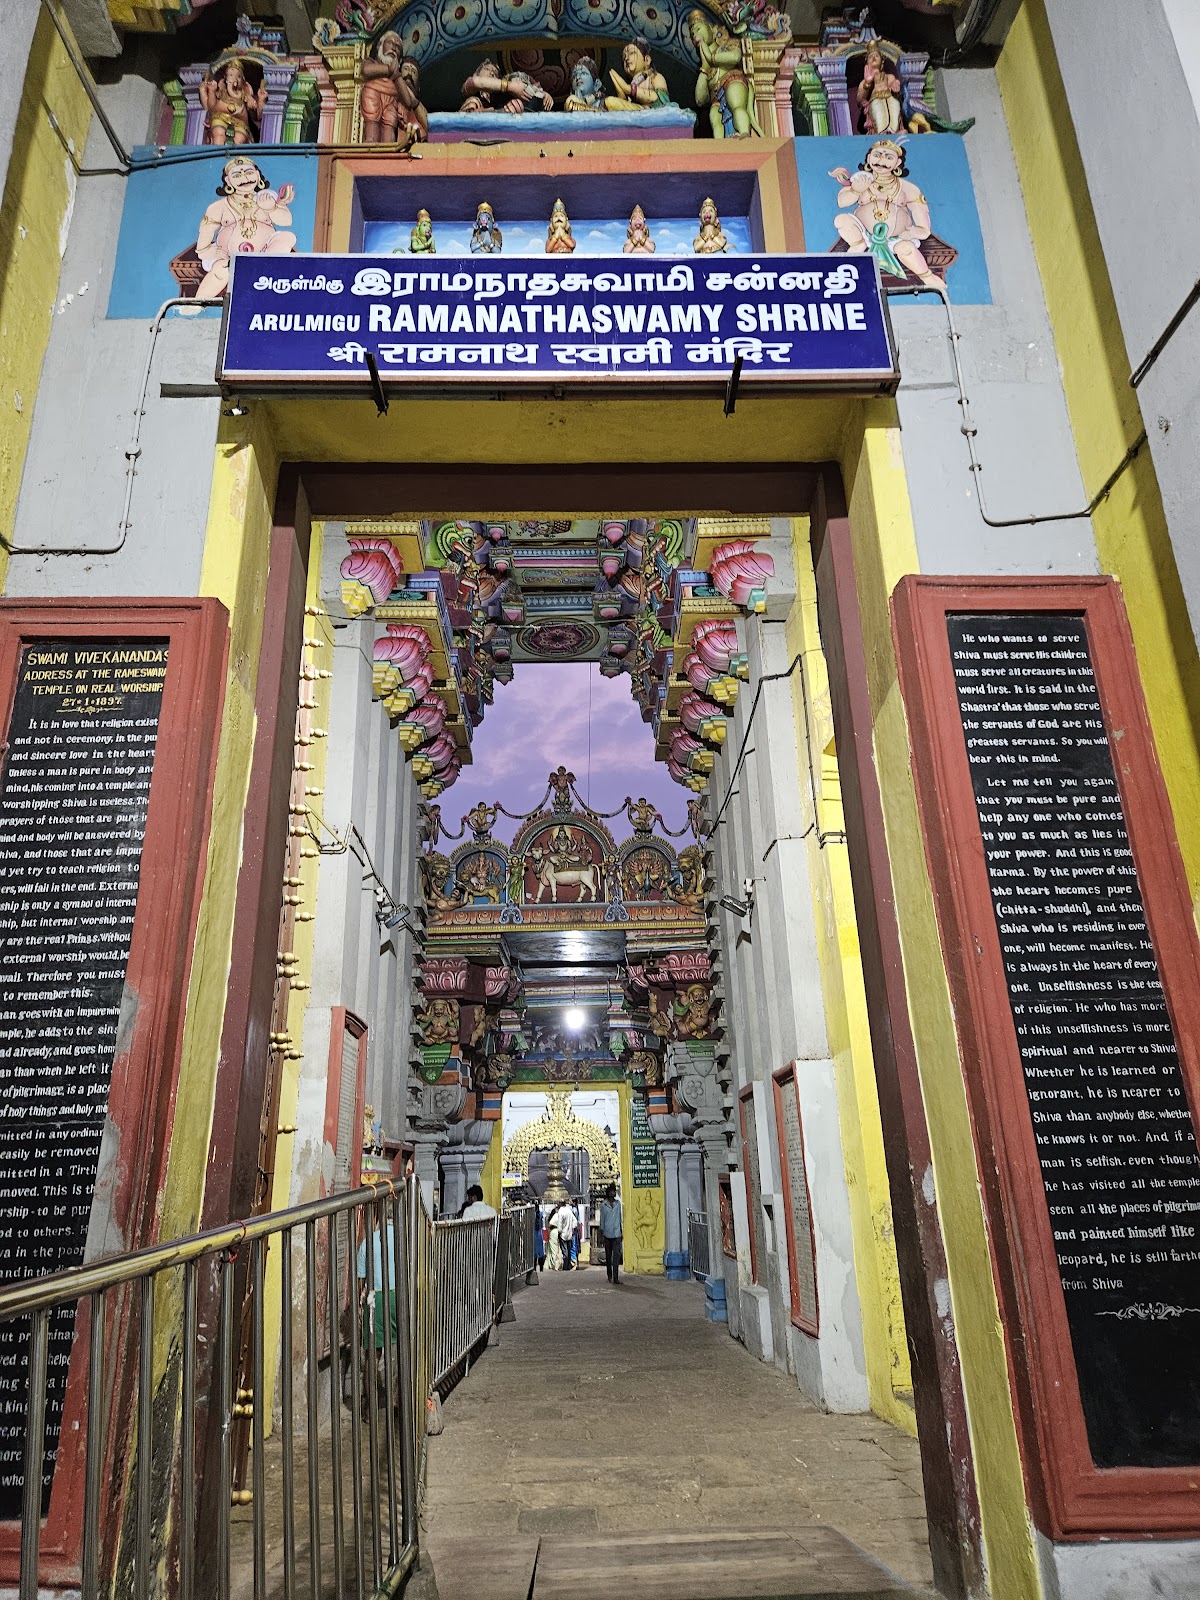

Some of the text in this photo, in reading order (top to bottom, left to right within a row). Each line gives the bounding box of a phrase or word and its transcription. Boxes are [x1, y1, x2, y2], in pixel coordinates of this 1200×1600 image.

[254, 264, 859, 301] அருள்மிகு இராமநாதசுவாமி சன்னதி
[249, 303, 866, 337] ARULMIGU RAMANATHASWAMY SHRINE
[327, 337, 792, 364] श्री रामनाथ स्वामी मंदिर
[962, 634, 975, 642] He
[978, 635, 1000, 643] who
[28, 653, 68, 665] SWAMI
[983, 651, 1008, 659] must
[1036, 651, 1050, 659] His
[1051, 649, 1087, 659] children
[24, 670, 73, 681] ADDRESS
[75, 670, 88, 679] AT
[92, 669, 111, 678] THE
[33, 685, 72, 695] TEMPLE
[76, 685, 88, 693] ON
[91, 684, 116, 693] REAL
[958, 684, 985, 694] world
[1014, 685, 1023, 693] It
[1025, 684, 1036, 694] is
[1039, 683, 1062, 694] said
[1064, 684, 1075, 693] in
[1077, 683, 1095, 693] the
[28, 719, 37, 729] It
[40, 720, 48, 729] is
[51, 720, 59, 728] in
[62, 720, 79, 728] love
[101, 718, 134, 728] religion
[53, 735, 63, 743] in
[116, 734, 125, 742] in
[127, 734, 142, 742] the
[968, 738, 1008, 748] greatest
[1062, 737, 1072, 745] So
[12, 749, 156, 761] and sincere love in the heart
[970, 754, 991, 763] bear
[996, 754, 1015, 763] this
[1032, 754, 1060, 762] mind.
[69, 767, 77, 775] is
[79, 768, 100, 776] pure
[103, 765, 111, 774] in
[115, 766, 135, 775] body
[987, 778, 1006, 786] Let
[1033, 778, 1052, 786] tell
[1060, 779, 1077, 787] you
[1084, 779, 1114, 787] again
[976, 796, 1000, 805] that
[1004, 797, 1022, 806] you
[1056, 795, 1068, 803] be
[1073, 796, 1096, 806] pure
[1102, 793, 1121, 803] and
[980, 812, 1003, 825] help
[1007, 814, 1029, 823] any
[1056, 812, 1081, 821] who
[1086, 812, 1123, 821] comes
[982, 832, 994, 841] to
[997, 832, 1016, 841] you
[1040, 830, 1069, 839] much
[1074, 831, 1088, 839] as
[1092, 830, 1112, 838] lies
[1117, 829, 1127, 838] in
[8, 863, 139, 877] yet try to teach religion to
[17, 884, 33, 893] will
[34, 883, 49, 893] fail
[51, 883, 60, 892] in
[61, 883, 76, 892] the
[1026, 943, 1045, 952] will
[1090, 941, 1137, 951] manifest.
[1140, 940, 1153, 949] He
[3, 992, 14, 1001] to
[17, 990, 69, 1000] remember
[1018, 1024, 1170, 1034] of this unselfishness is more
[1025, 1068, 1074, 1077] Whether
[1080, 1065, 1094, 1076] he
[1098, 1066, 1108, 1076] is
[1111, 1065, 1156, 1075] learned
[1087, 1086, 1103, 1098] he
[1107, 1088, 1117, 1098] is
[1122, 1088, 1161, 1098] nearer
[1167, 1088, 1180, 1096] to
[1036, 1133, 1049, 1144] he
[1052, 1135, 1085, 1144] knows
[1090, 1133, 1098, 1143] it
[1102, 1135, 1113, 1143] or
[1118, 1134, 1140, 1142] not.
[1146, 1132, 1169, 1142] And
[1175, 1130, 1182, 1141] if
[35, 1149, 47, 1158] be
[51, 1146, 98, 1157] removed
[1054, 1225, 1194, 1241] and painted himself like
[1062, 1278, 1087, 1289] from
